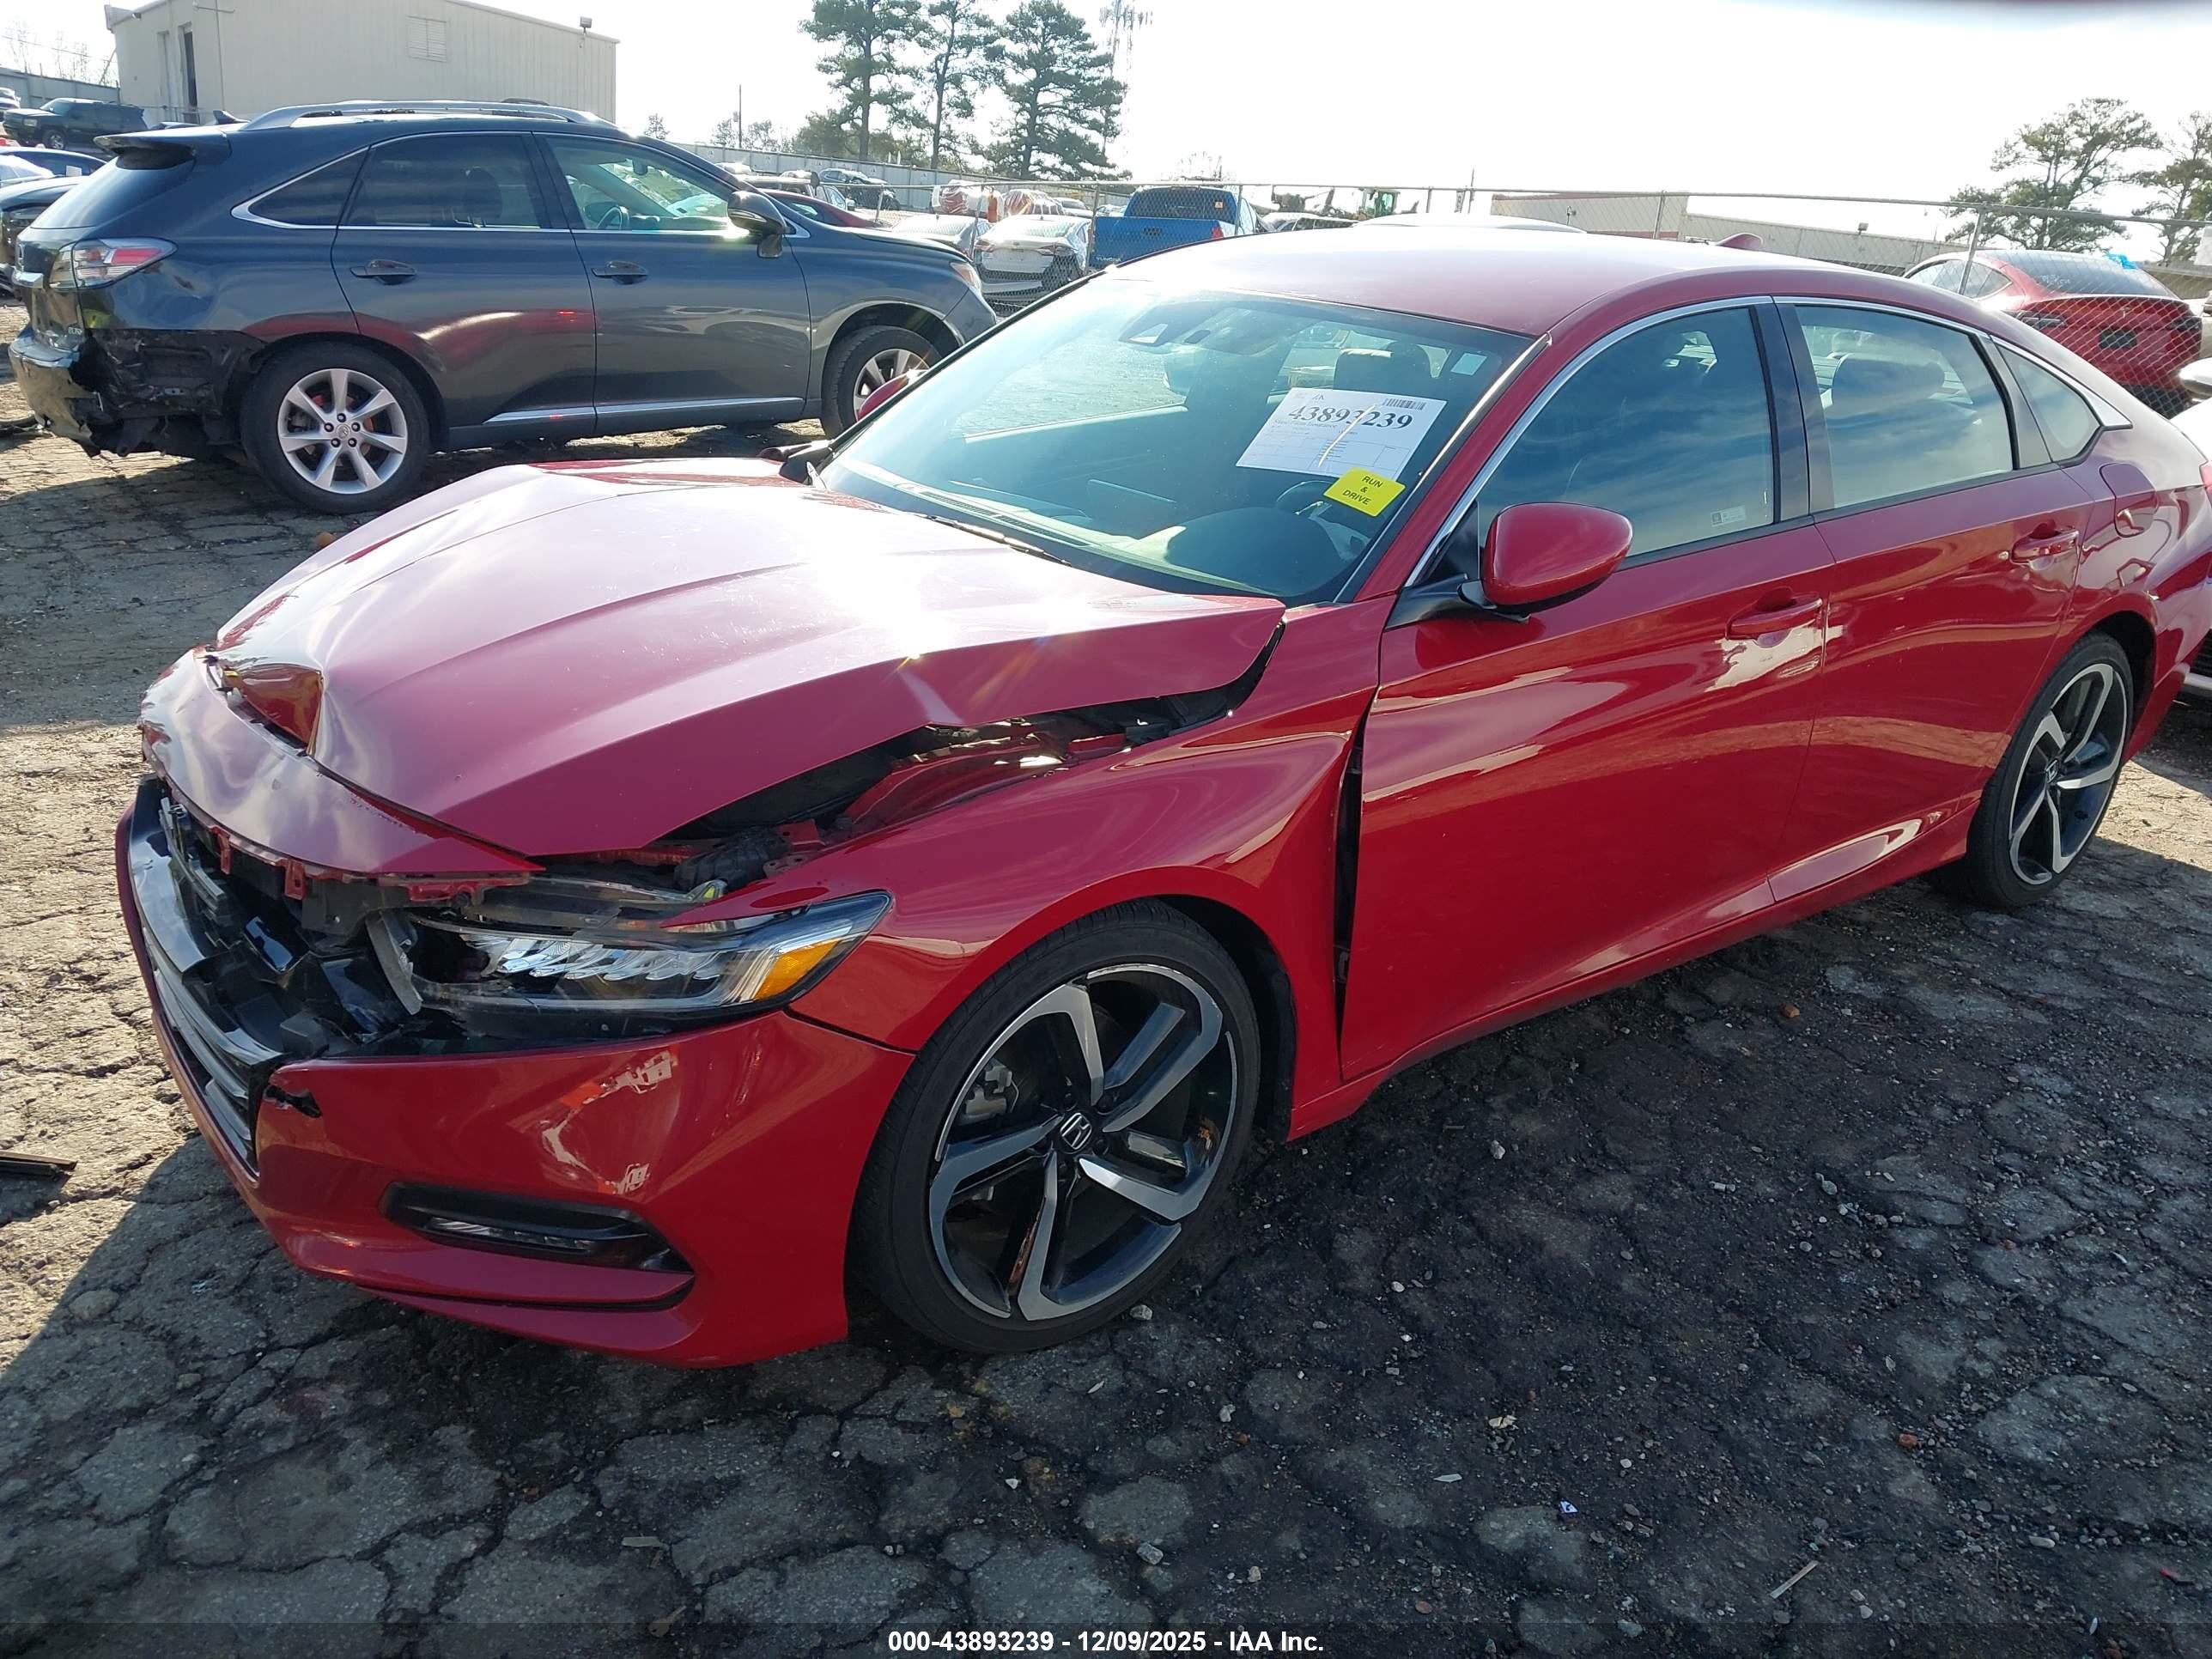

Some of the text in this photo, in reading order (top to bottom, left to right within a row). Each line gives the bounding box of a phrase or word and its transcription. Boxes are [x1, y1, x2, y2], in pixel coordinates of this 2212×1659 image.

[1288, 405, 1413, 429] 43893239
[1362, 476, 1382, 488] RUN
[1343, 490, 1372, 505] DRIVE
